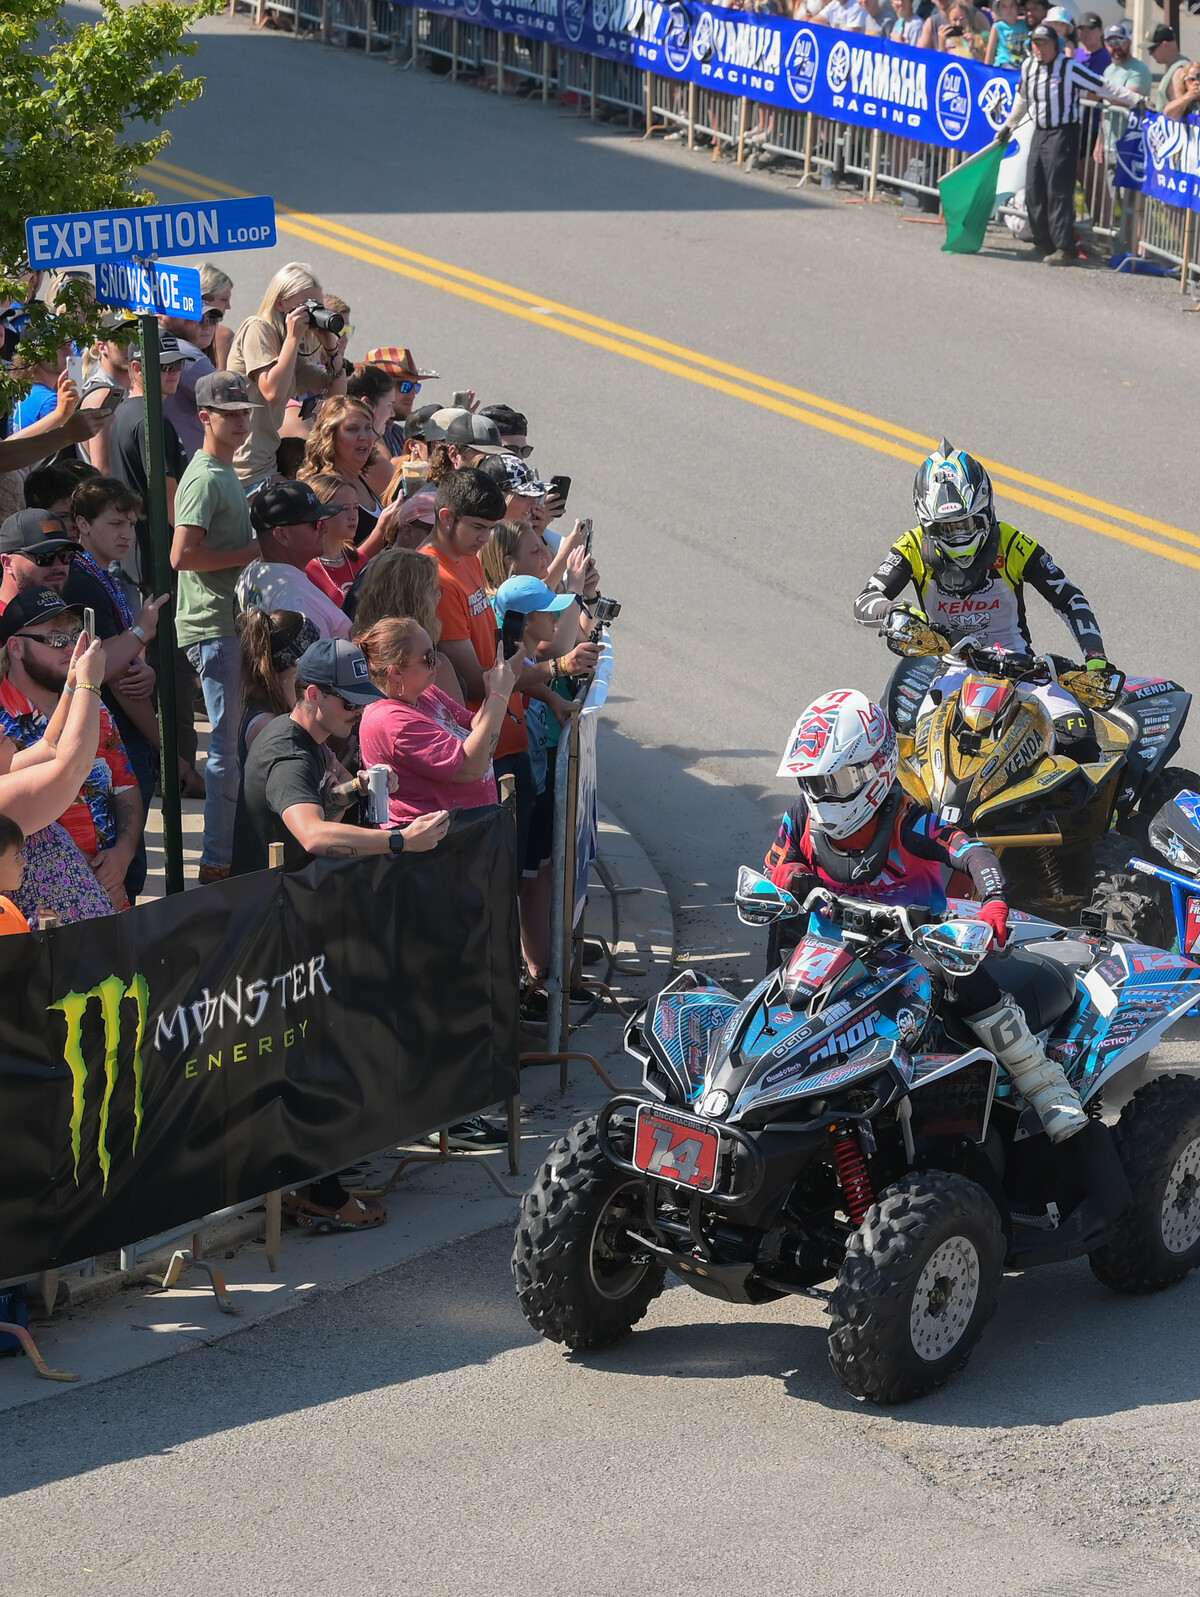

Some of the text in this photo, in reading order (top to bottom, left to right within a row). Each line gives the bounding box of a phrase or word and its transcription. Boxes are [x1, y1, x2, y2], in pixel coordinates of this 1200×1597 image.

[701, 63, 775, 93] RACING
[850, 47, 929, 111] YAMAHA
[832, 94, 922, 128] RACING
[32, 208, 271, 261] EXPEDITION LOOP
[100, 262, 195, 313] SNOWSHOE DR
[937, 599, 1000, 615] KENDA
[971, 685, 998, 708] 1
[1135, 680, 1175, 699] KENDA
[1003, 728, 1044, 779] KENDA
[946, 806, 956, 821] 1
[804, 938, 842, 953] WHARFF
[956, 925, 987, 951] 14
[786, 946, 839, 981] 14
[1133, 955, 1190, 971] 14
[721, 1010, 744, 1044] OGIO
[773, 1027, 812, 1059] OGIO
[184, 1019, 308, 1079] ENERGY
[647, 1127, 704, 1182] 14
